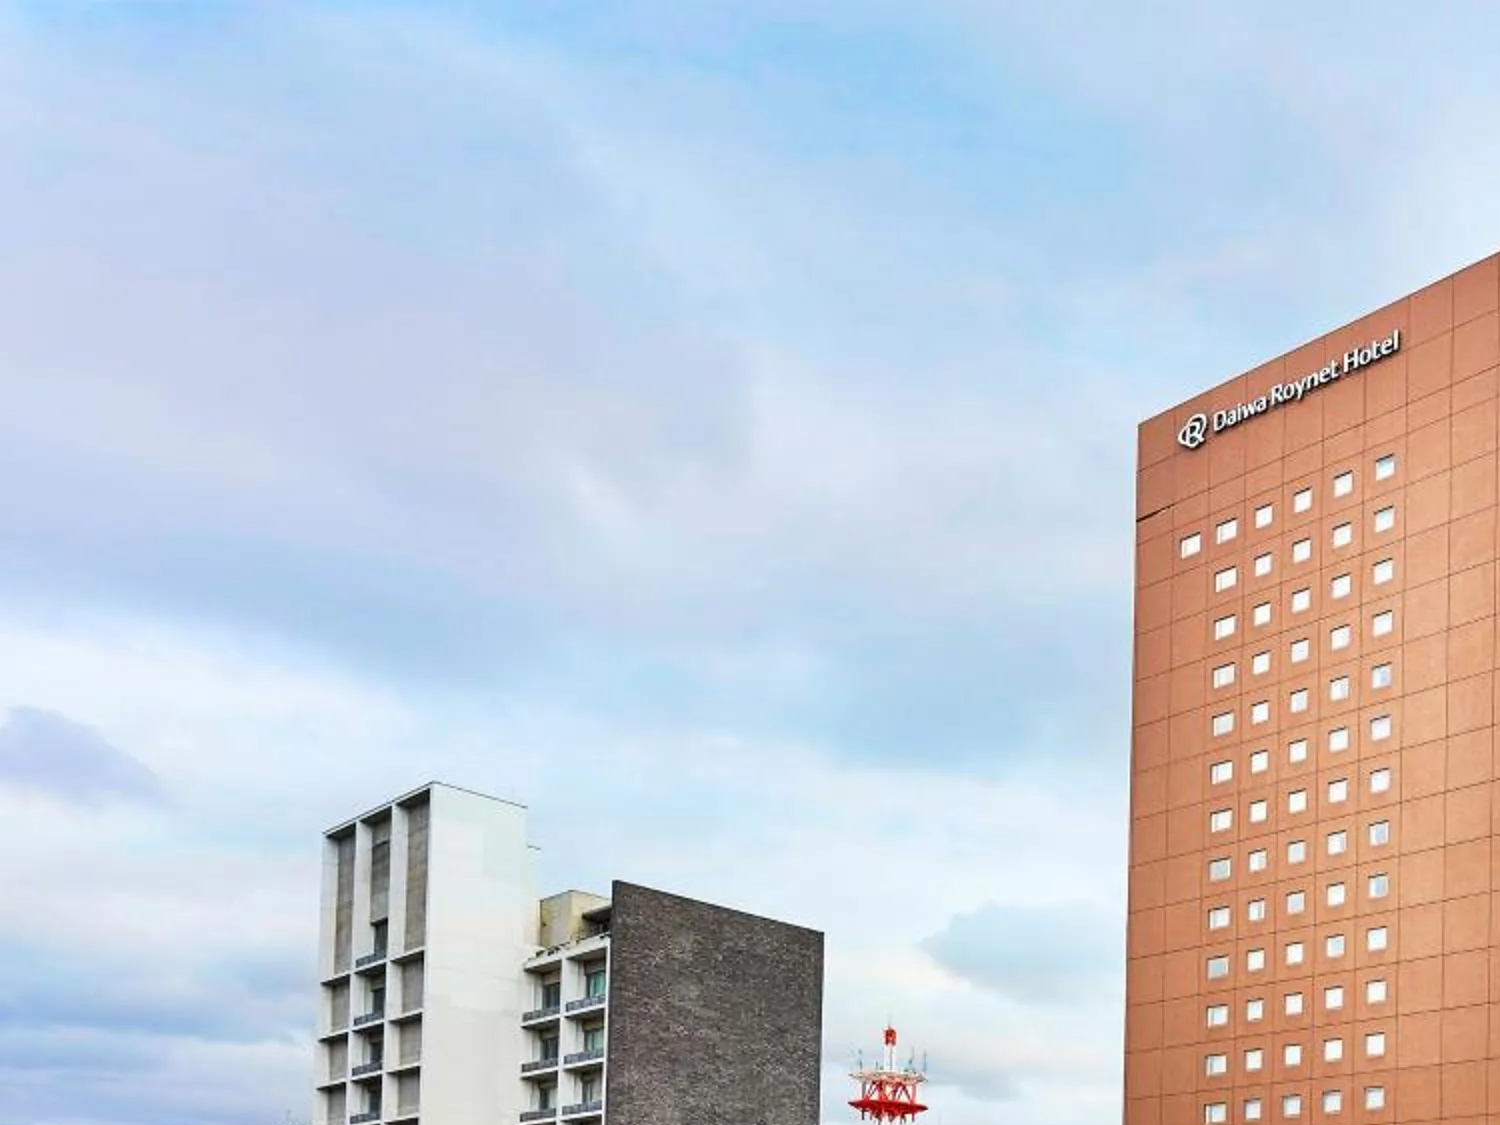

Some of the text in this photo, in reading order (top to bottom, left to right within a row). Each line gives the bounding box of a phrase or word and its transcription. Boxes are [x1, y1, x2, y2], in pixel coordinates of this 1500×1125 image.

[1213, 395, 1267, 432] Daiwa
[1271, 360, 1340, 406] Roynet
[1342, 328, 1400, 373] Hotel
